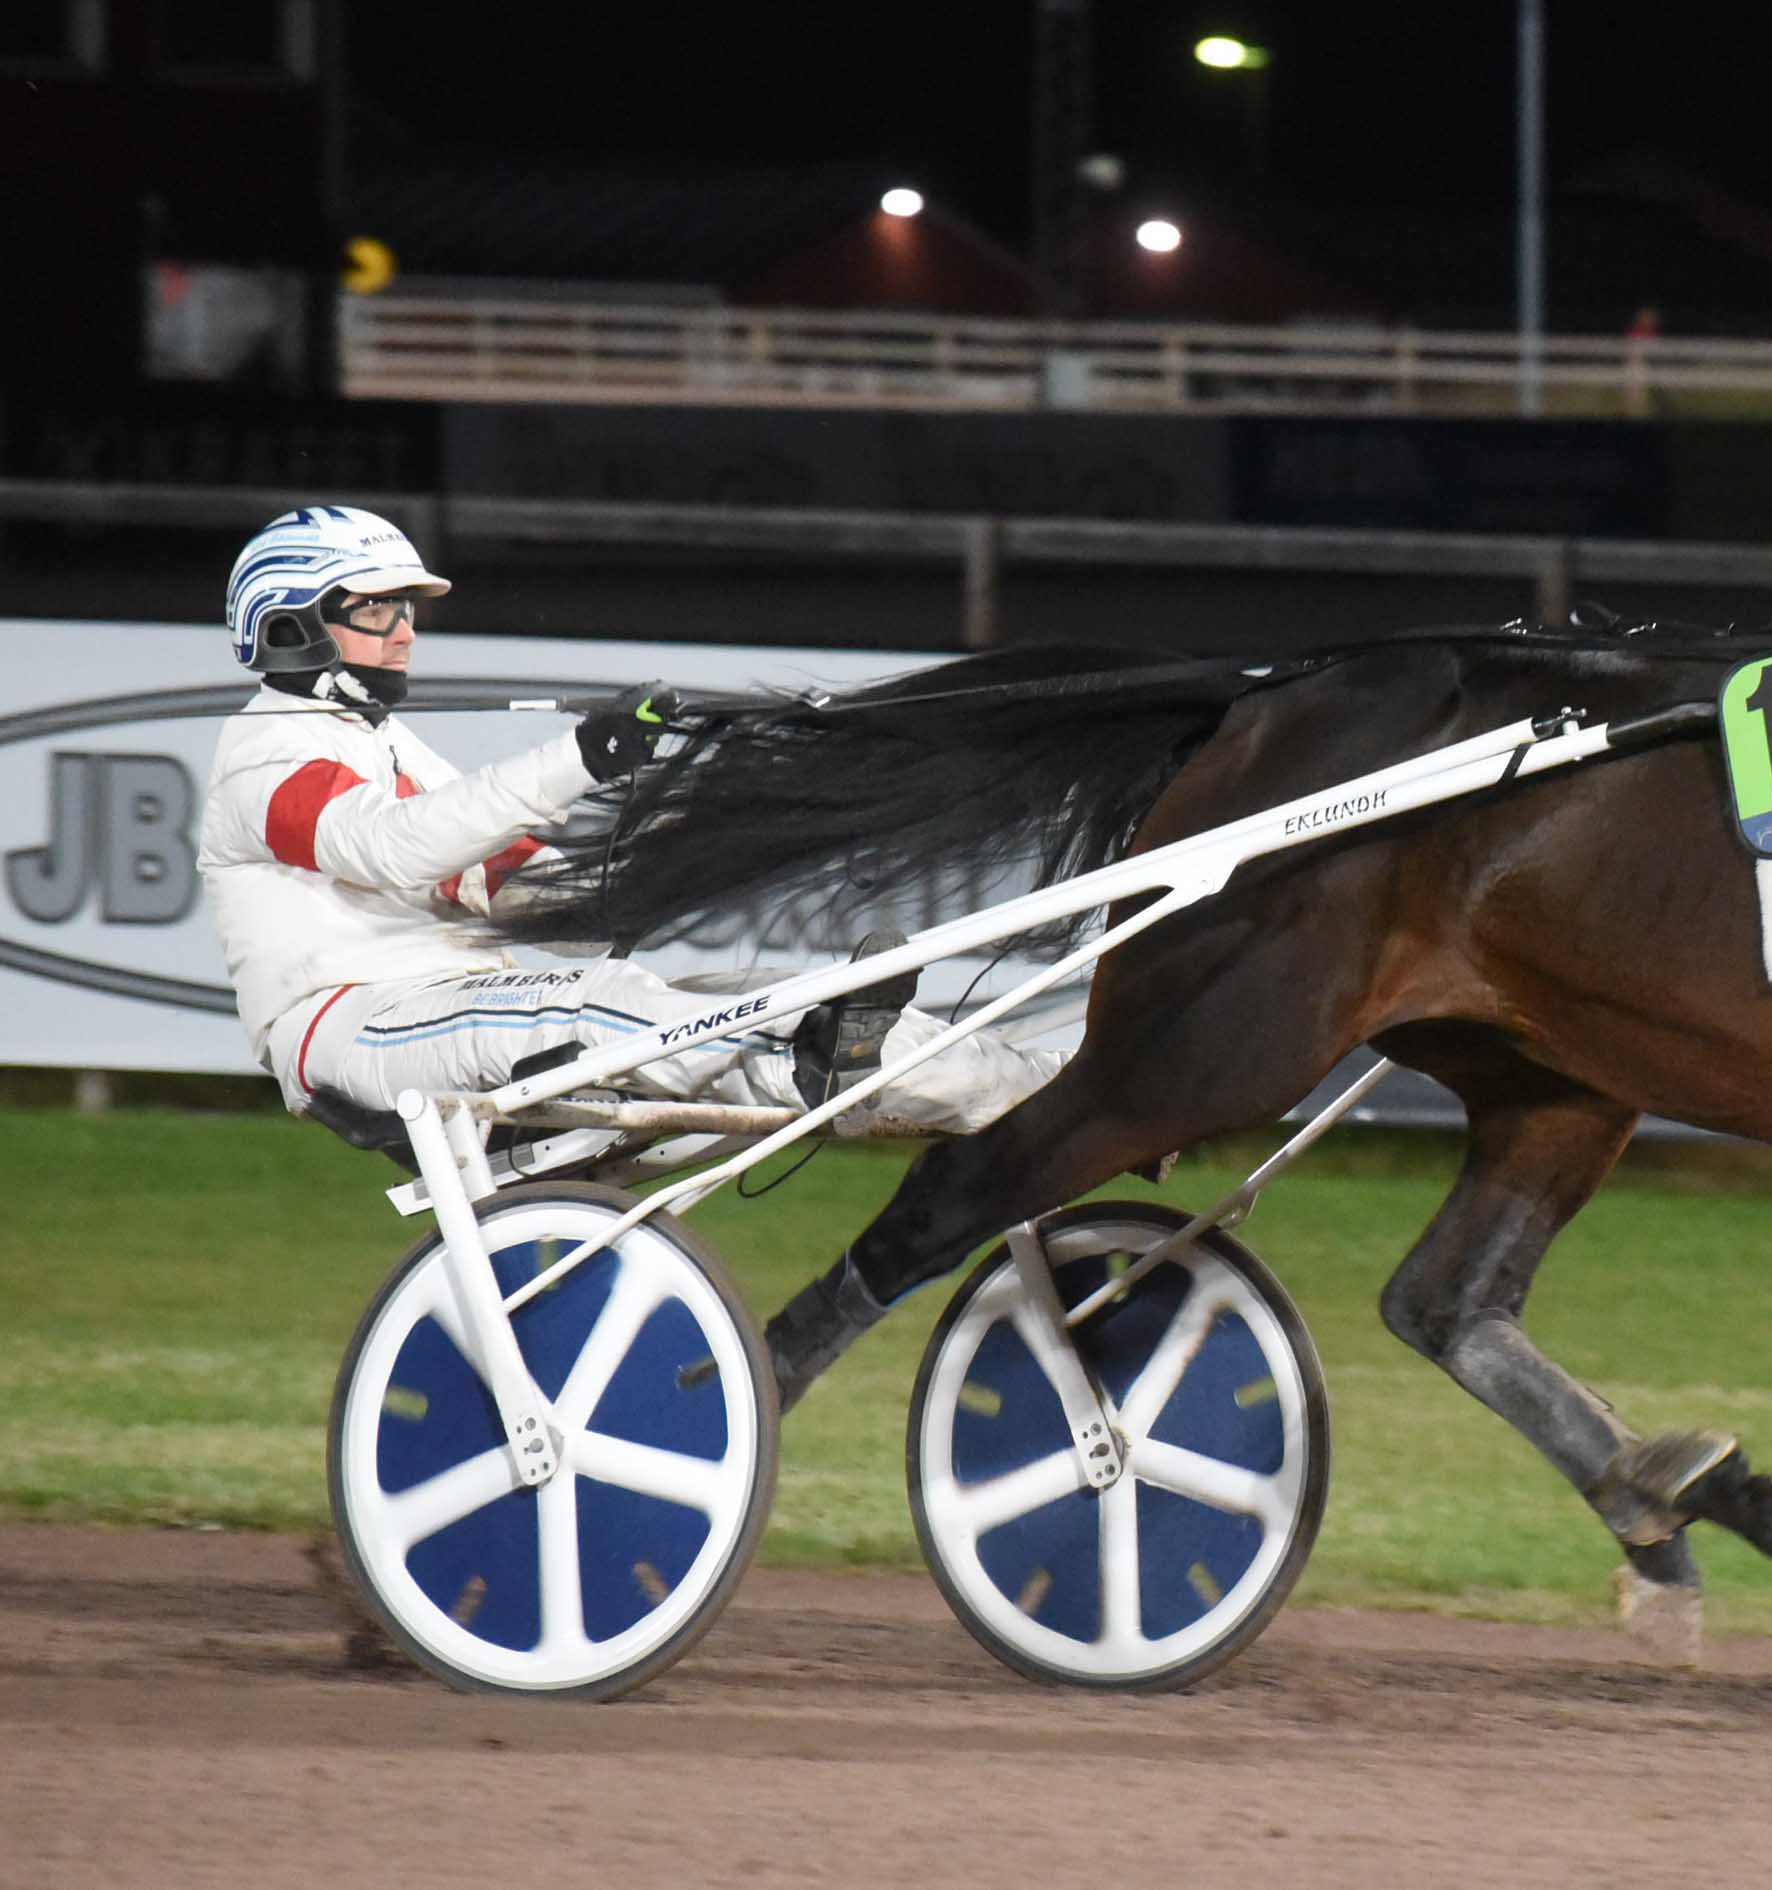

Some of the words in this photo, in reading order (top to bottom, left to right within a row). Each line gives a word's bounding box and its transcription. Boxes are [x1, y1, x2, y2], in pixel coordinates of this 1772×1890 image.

[1284, 789, 1388, 835] EKLUNDH
[4, 750, 197, 926] JB
[659, 995, 771, 1046] YANKEE
